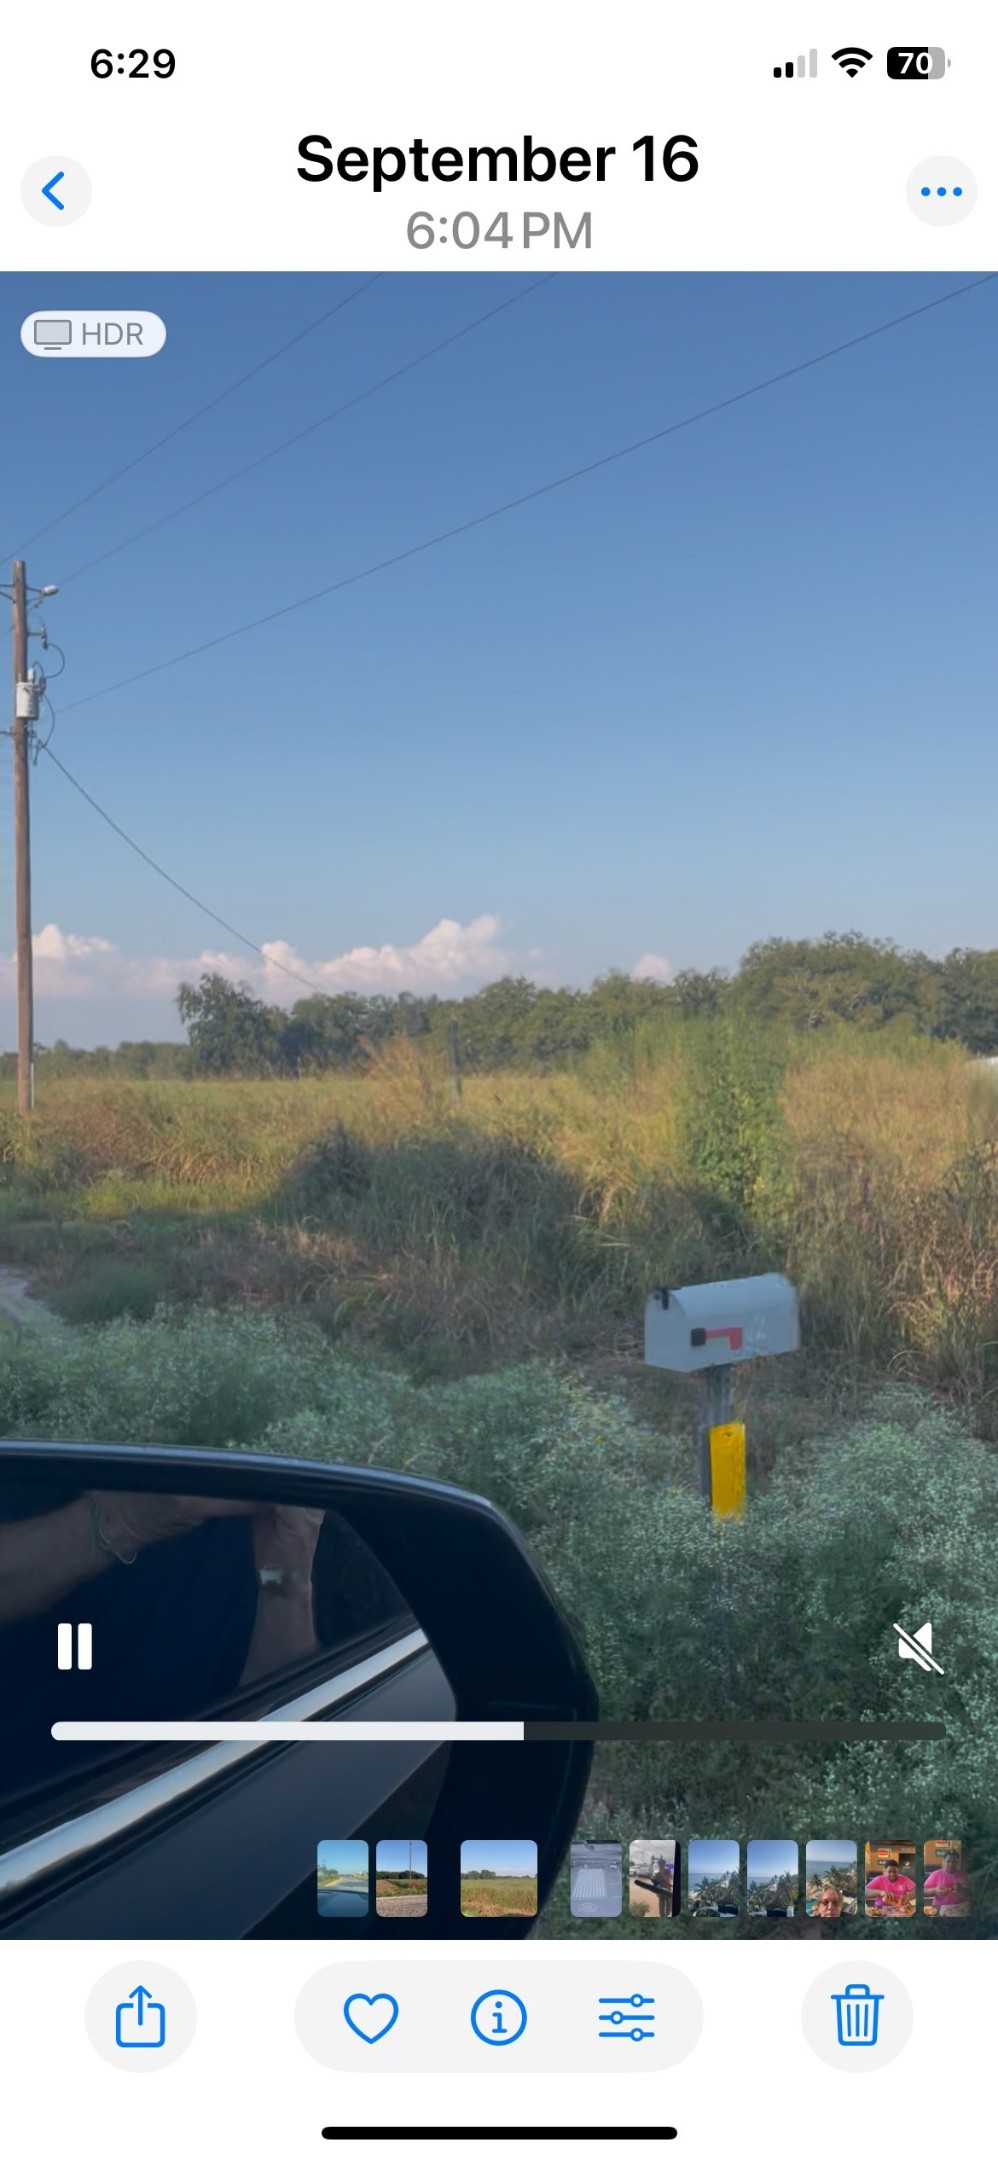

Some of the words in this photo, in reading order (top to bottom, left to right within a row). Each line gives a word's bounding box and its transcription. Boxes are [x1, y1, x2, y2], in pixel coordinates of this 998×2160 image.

[90, 49, 175, 79] 6:29
[898, 52, 933, 75] 70
[297, 135, 616, 192] September
[633, 136, 699, 183] 16
[406, 211, 514, 250] 6:04
[523, 211, 592, 249] PM
[82, 322, 144, 346] HDR
